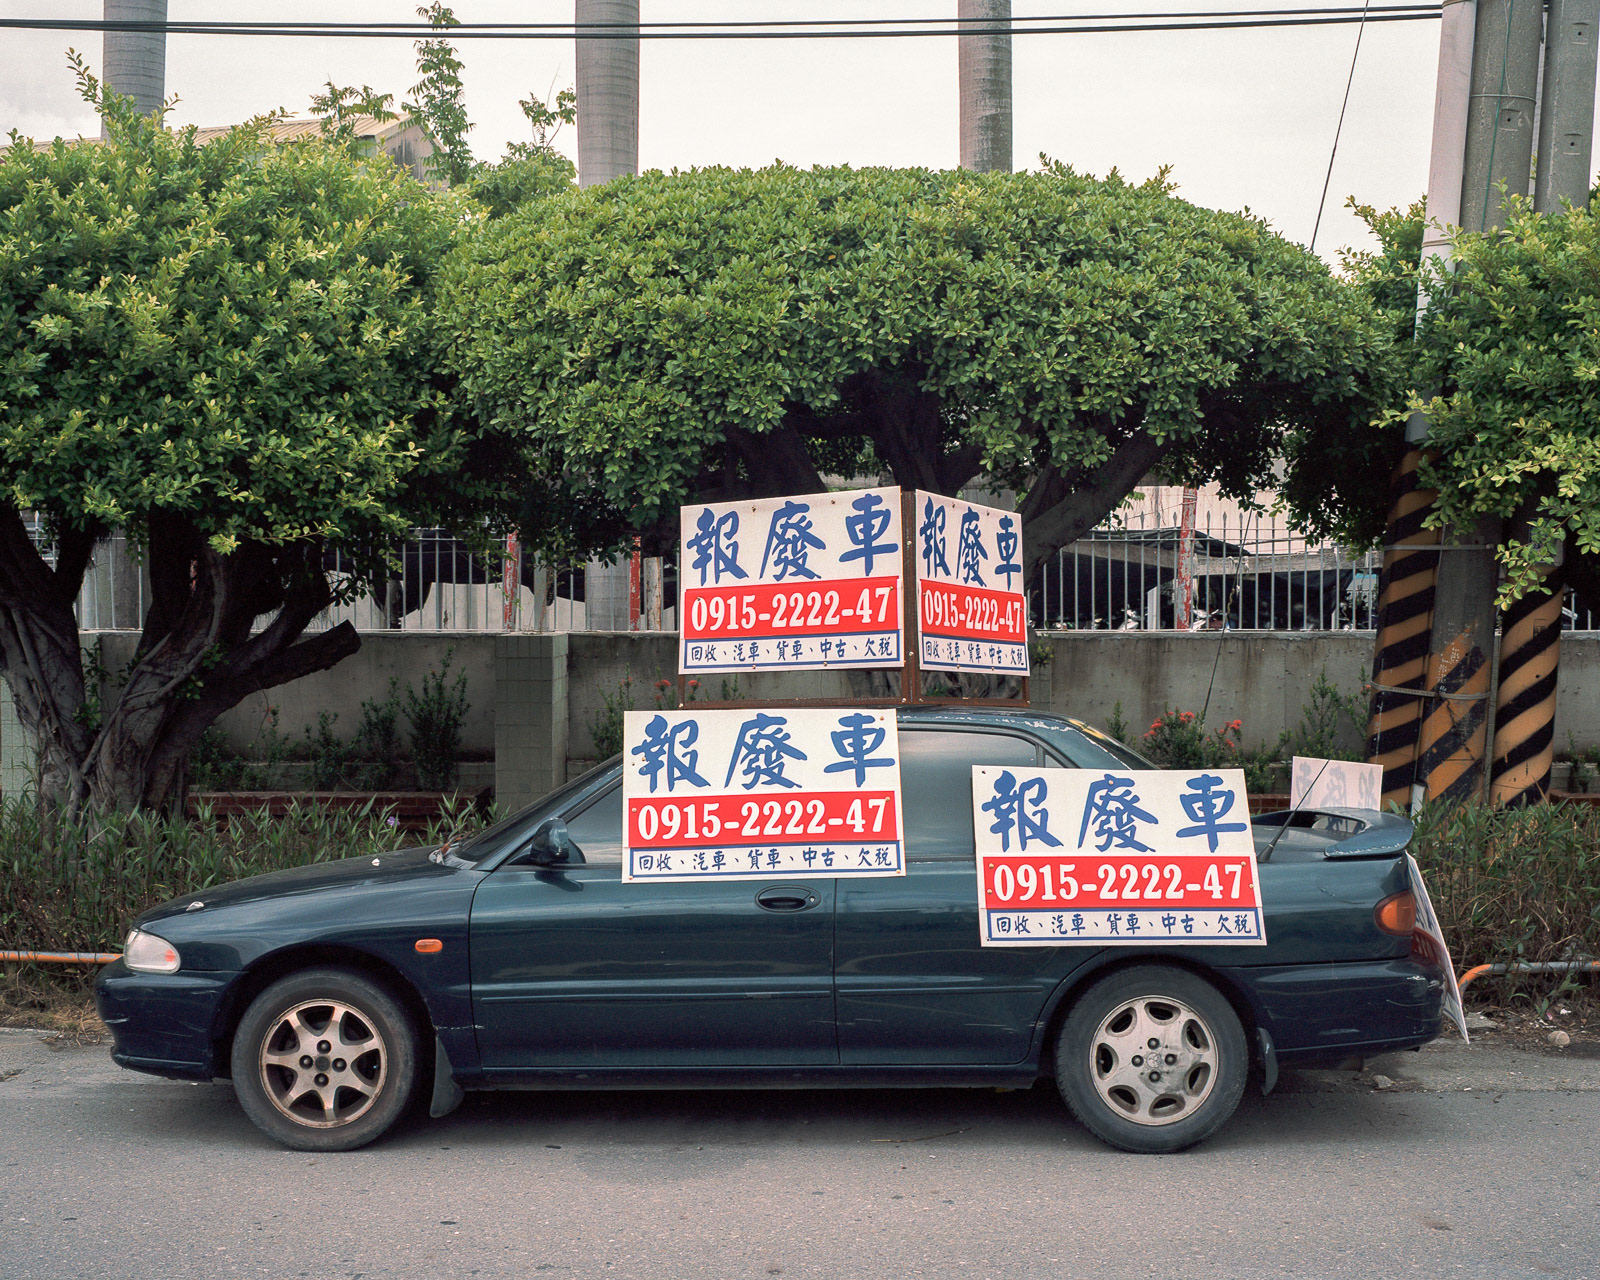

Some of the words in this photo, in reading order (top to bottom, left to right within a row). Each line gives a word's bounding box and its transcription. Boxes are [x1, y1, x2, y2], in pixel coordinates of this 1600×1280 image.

[687, 494, 899, 587] 報廢車
[920, 496, 1022, 591] 報廢車
[691, 587, 891, 631] 0915-2222-47
[925, 589, 1023, 634] 0915-2222-47
[631, 712, 896, 793] 報廢車
[638, 799, 888, 840] 0915-2222-47
[981, 770, 1247, 853] 報廢車
[993, 863, 1244, 901] 0915-2222-47
